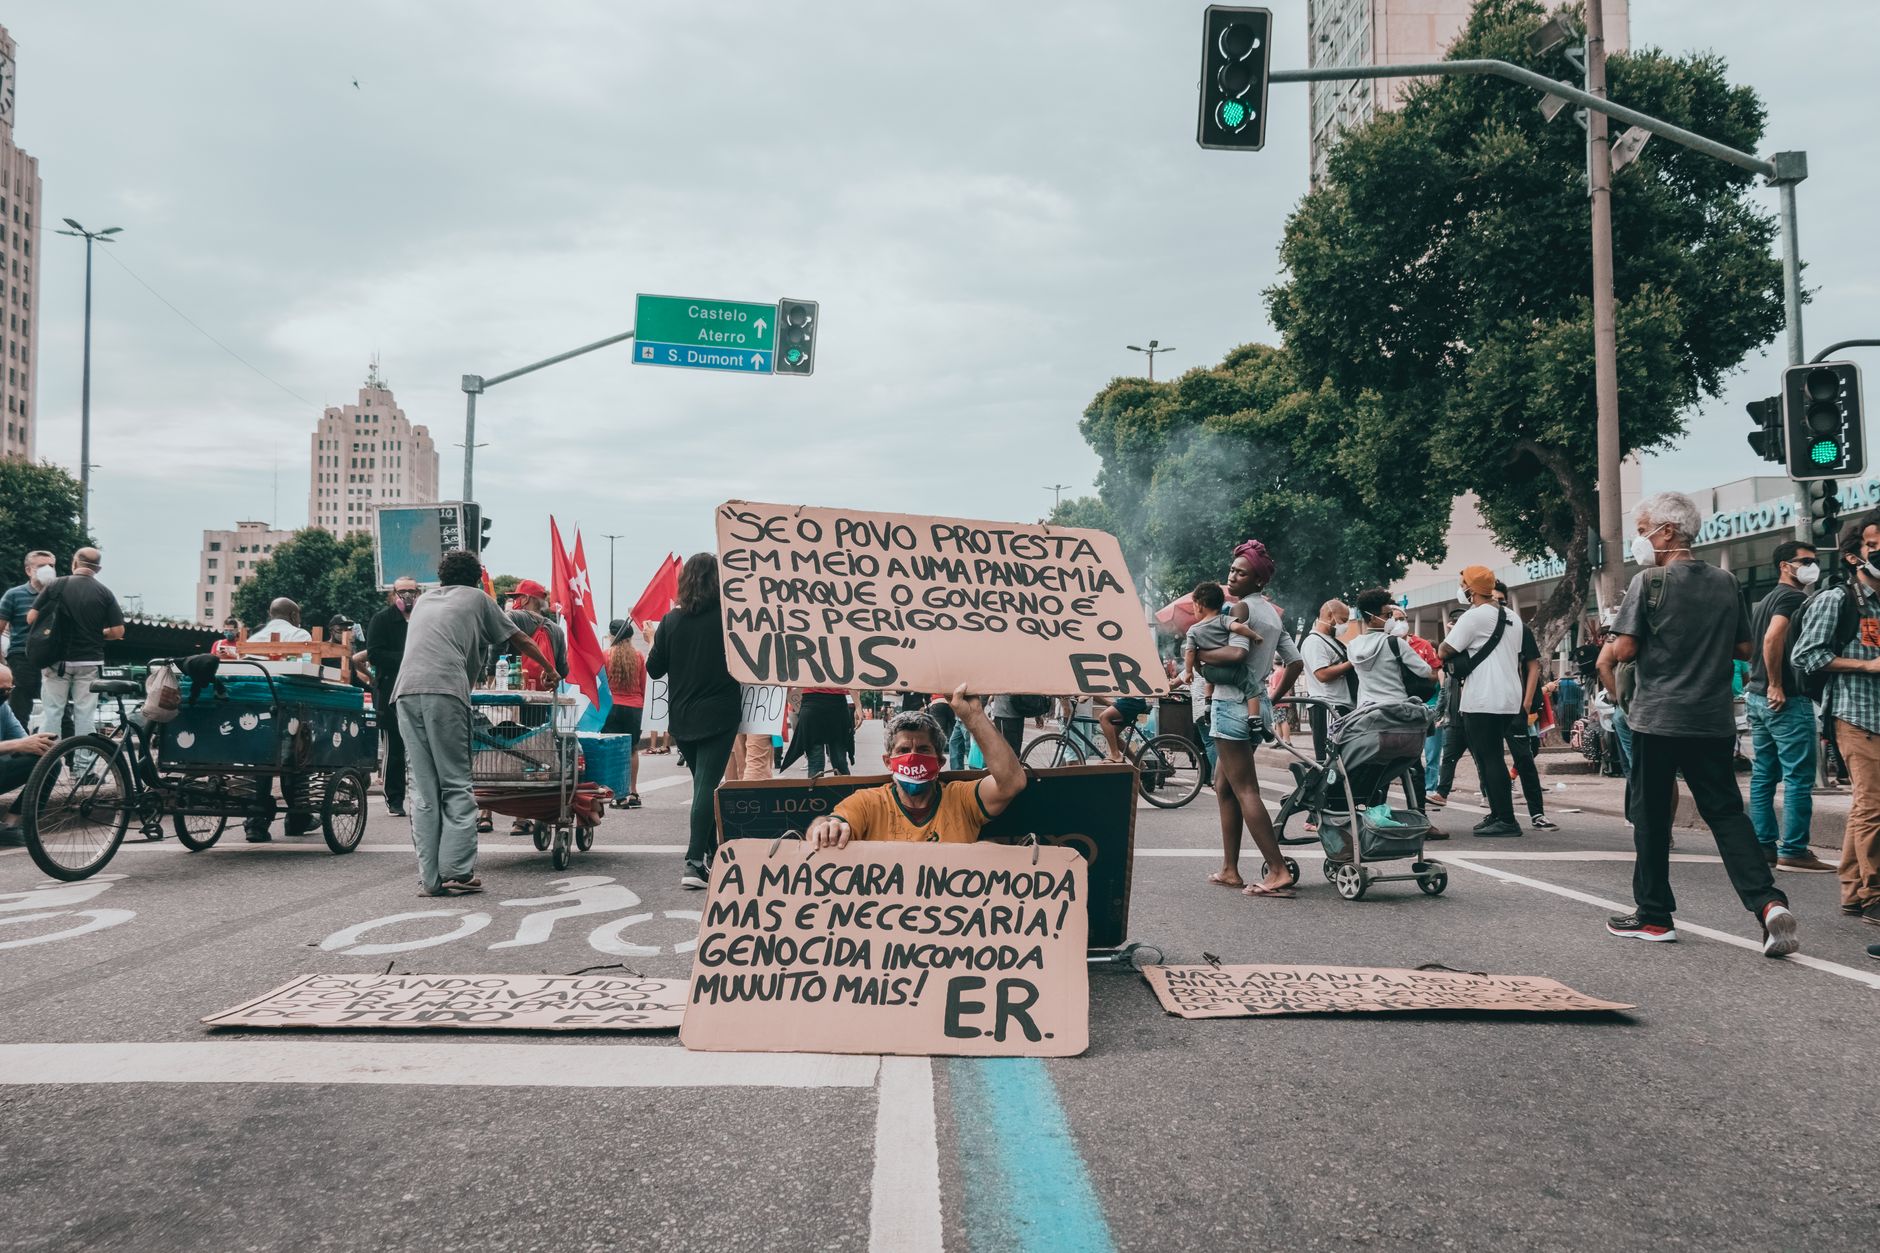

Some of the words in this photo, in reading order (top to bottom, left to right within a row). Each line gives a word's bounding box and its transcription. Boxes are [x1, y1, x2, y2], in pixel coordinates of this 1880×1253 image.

[688, 305, 747, 322] Castelo
[698, 328, 746, 344] Aterro
[668, 349, 682, 362] S.
[687, 350, 743, 367] Dumont
[440, 508, 453, 518] 10
[796, 517, 823, 543] O
[835, 518, 917, 551] POVO
[930, 523, 1101, 563] PROTESTA
[722, 548, 781, 572] EM
[791, 548, 879, 577] MEIO
[887, 557, 910, 579] A
[911, 555, 971, 585] UMA
[976, 558, 1125, 594] PANDEMIA
[722, 573, 755, 604] É
[760, 577, 878, 606] PORQUE
[890, 583, 914, 606] O
[923, 586, 1071, 616] GOVERNO
[1072, 594, 1100, 617] É
[727, 604, 810, 632] MAIS
[822, 605, 1008, 634] PERIGOSO
[1016, 615, 1085, 641] QUE
[1097, 620, 1124, 641] O
[898, 764, 927, 776] FORA
[772, 798, 828, 813] Q70T
[756, 851, 904, 897] MÁSCARA
[916, 864, 1076, 901] INCOMODA
[707, 899, 782, 932] MAS
[795, 898, 831, 930] É
[828, 898, 1070, 940] NECESSÁRIA!
[699, 931, 871, 969] GENOCIDA
[881, 942, 1044, 970] INCOMODA
[537, 978, 667, 992] TUDO
[693, 967, 827, 1004] MUUUITO
[832, 969, 930, 1007] MAIS!
[1167, 979, 1319, 990] MILHARES
[1331, 982, 1375, 990] DE
[1246, 971, 1390, 982] ADIANTA
[1408, 975, 1533, 988] REUNIR
[286, 990, 395, 1001] FOR
[407, 989, 651, 1001] PRIVADO
[1168, 987, 1363, 998] BOLSONARO
[261, 999, 507, 1010] SEREMOS
[241, 1009, 318, 1018] DE
